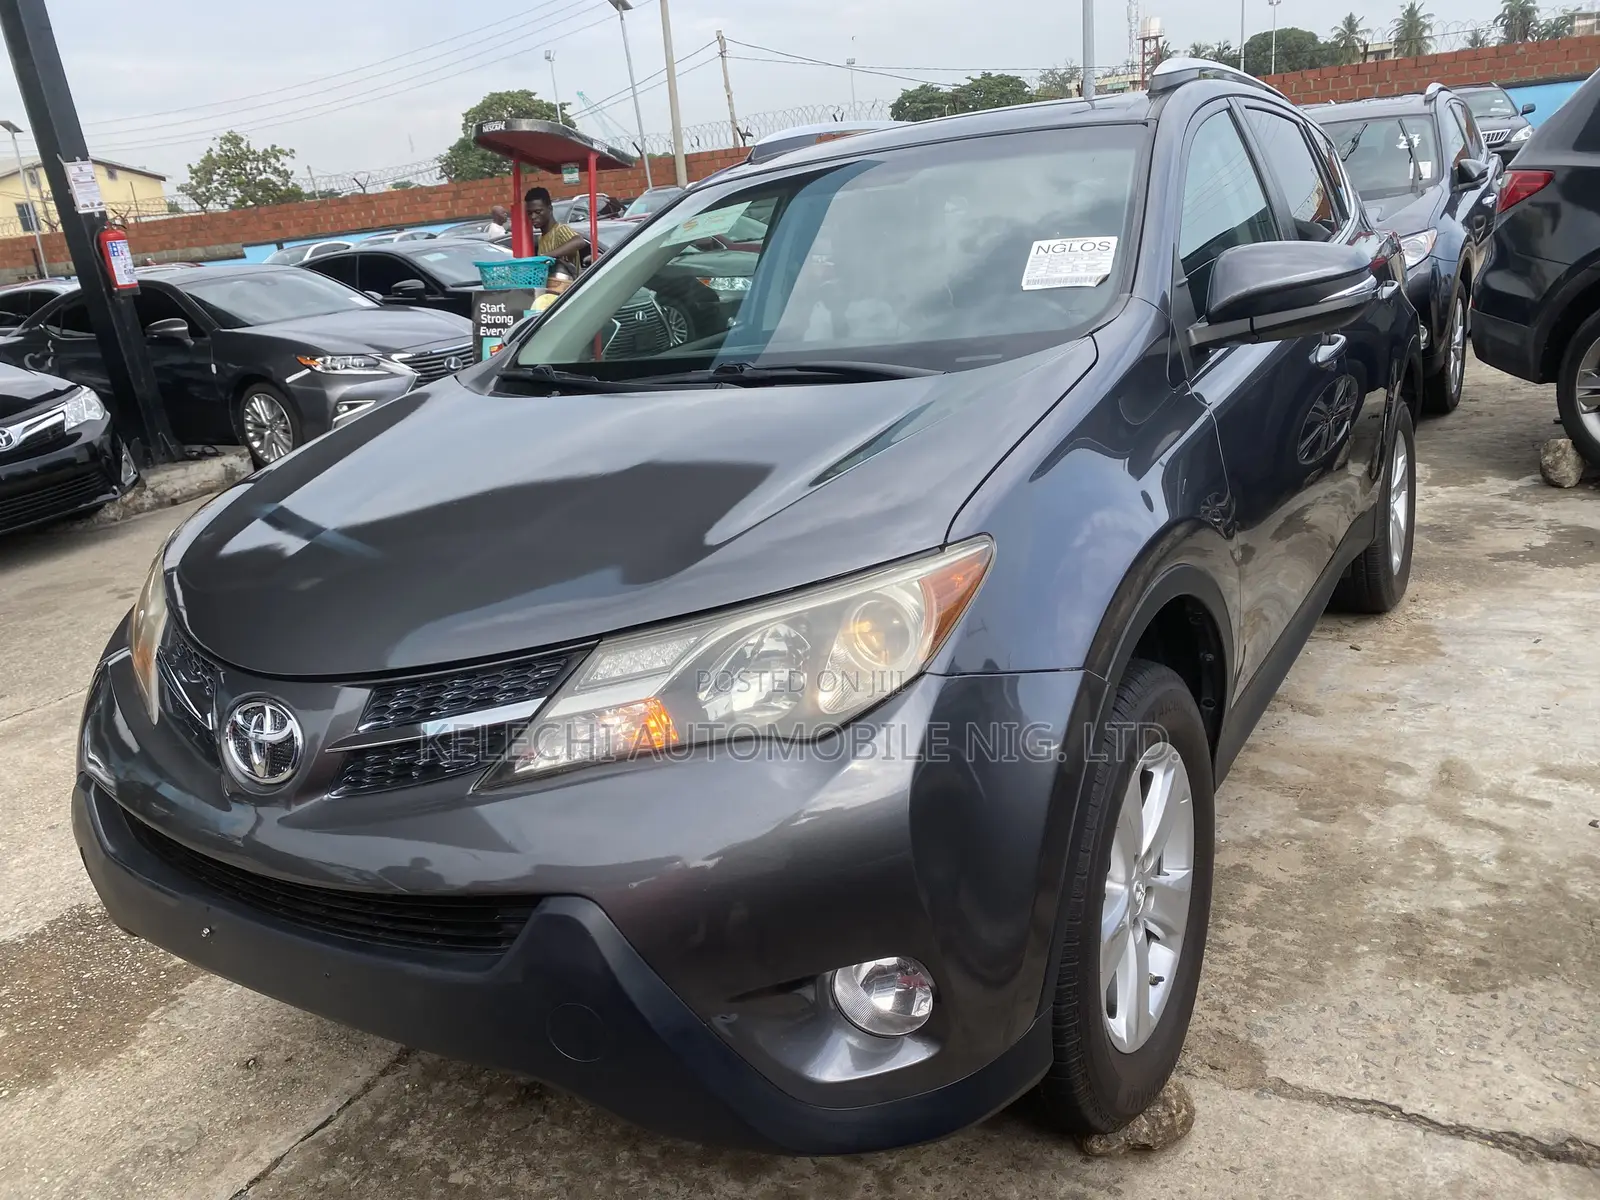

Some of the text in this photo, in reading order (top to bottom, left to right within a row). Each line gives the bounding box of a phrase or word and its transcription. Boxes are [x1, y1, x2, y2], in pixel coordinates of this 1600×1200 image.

[1036, 241, 1111, 255] NGLOS
[480, 303, 506, 313] Start
[480, 314, 514, 326] Strong
